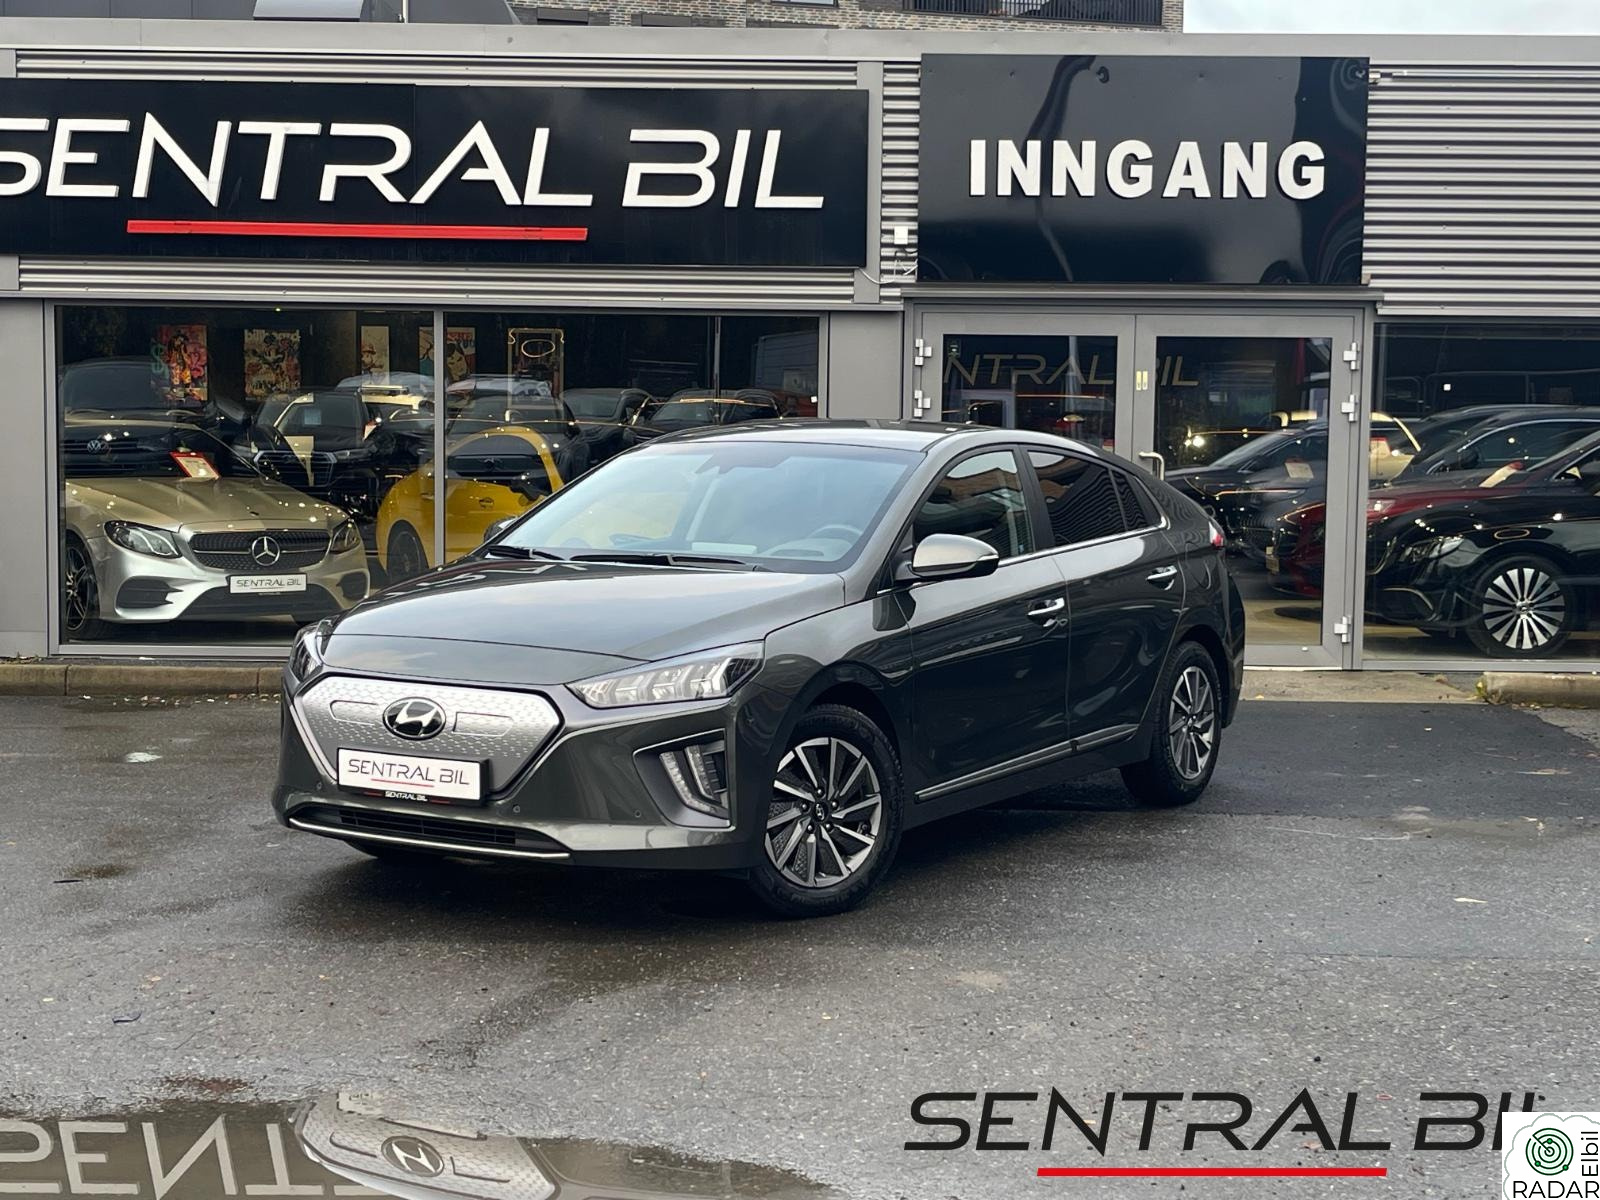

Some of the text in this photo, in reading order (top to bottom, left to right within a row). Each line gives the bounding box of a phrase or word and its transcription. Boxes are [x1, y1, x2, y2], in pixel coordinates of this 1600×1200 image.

[621, 128, 824, 208] BIL
[970, 139, 1325, 199] INNGANG
[1155, 355, 1199, 386] IL
[236, 578, 302, 587] SENTRAL BIL
[348, 759, 470, 785] SENTRAL BIL
[385, 790, 416, 800] SENTRAL
